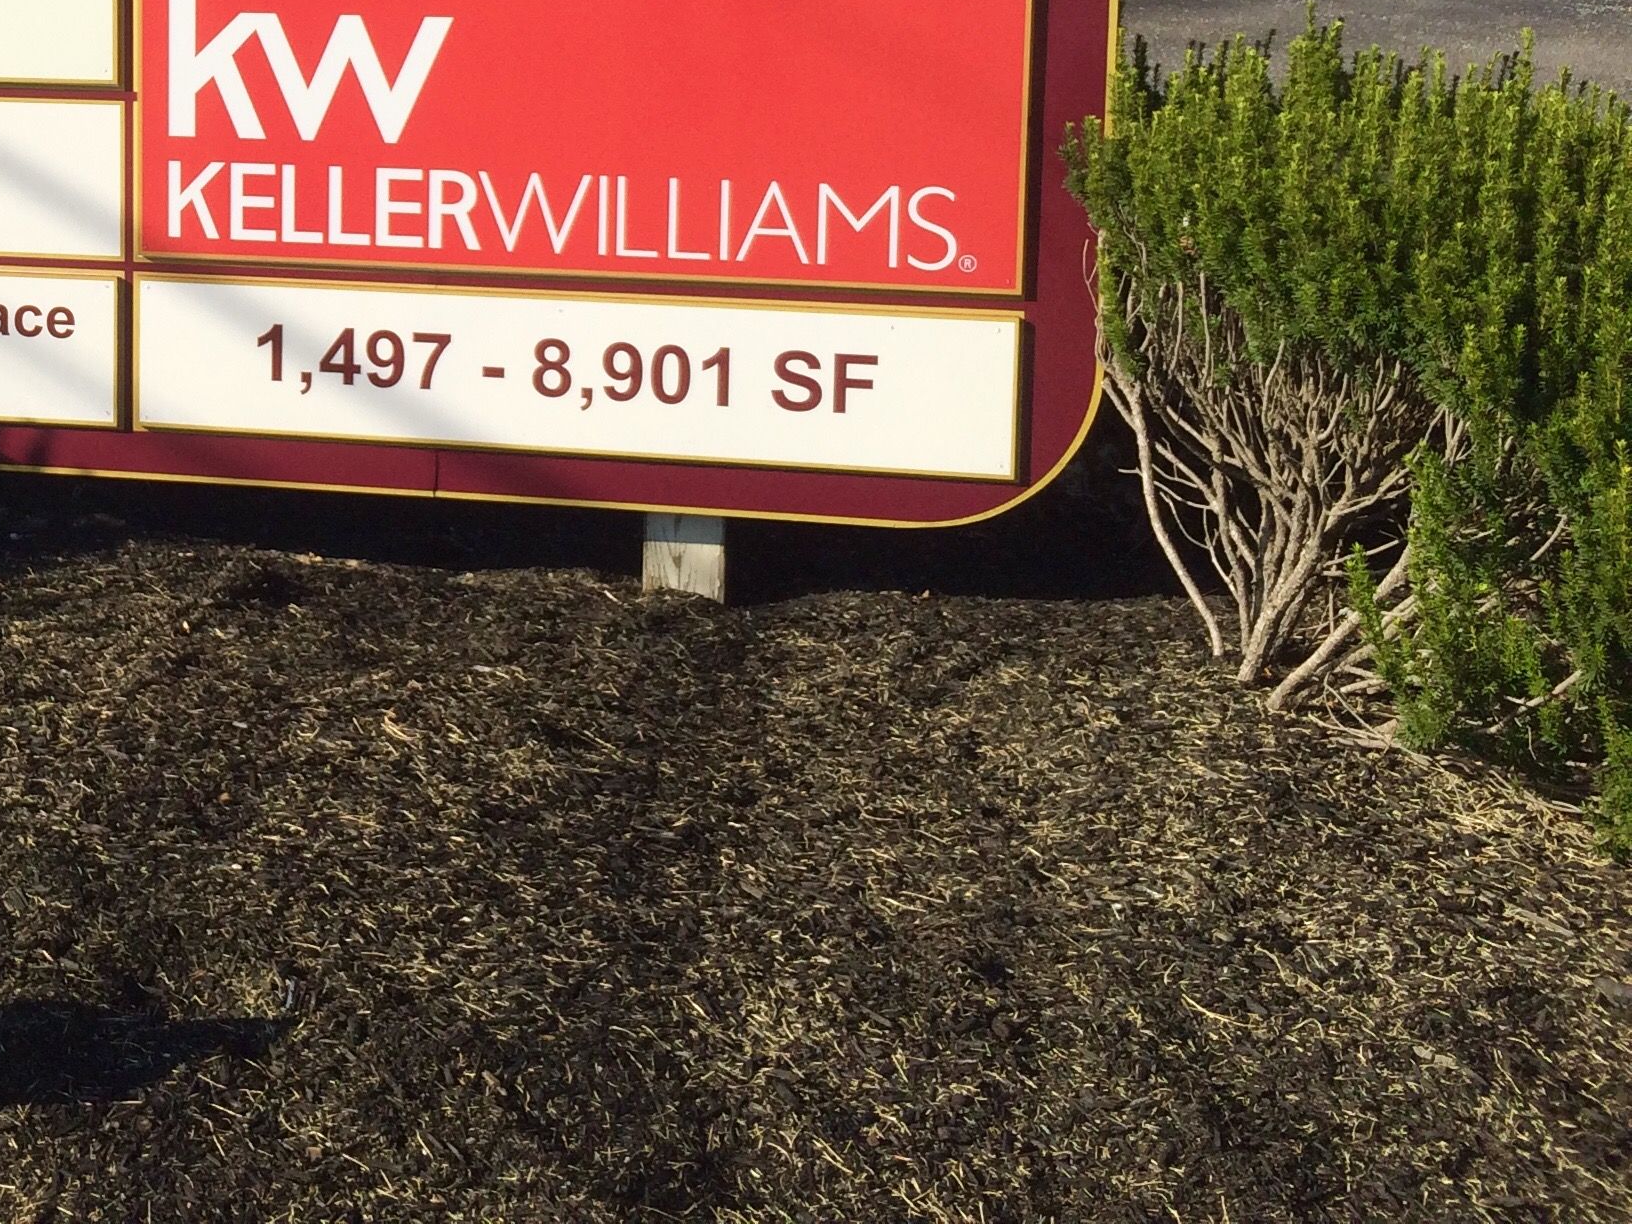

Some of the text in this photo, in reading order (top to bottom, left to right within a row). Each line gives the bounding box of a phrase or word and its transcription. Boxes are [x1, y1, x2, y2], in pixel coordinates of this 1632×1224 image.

[257, 324, 452, 395] 1,497
[533, 338, 730, 410] 8,901
[772, 350, 878, 414] SF
